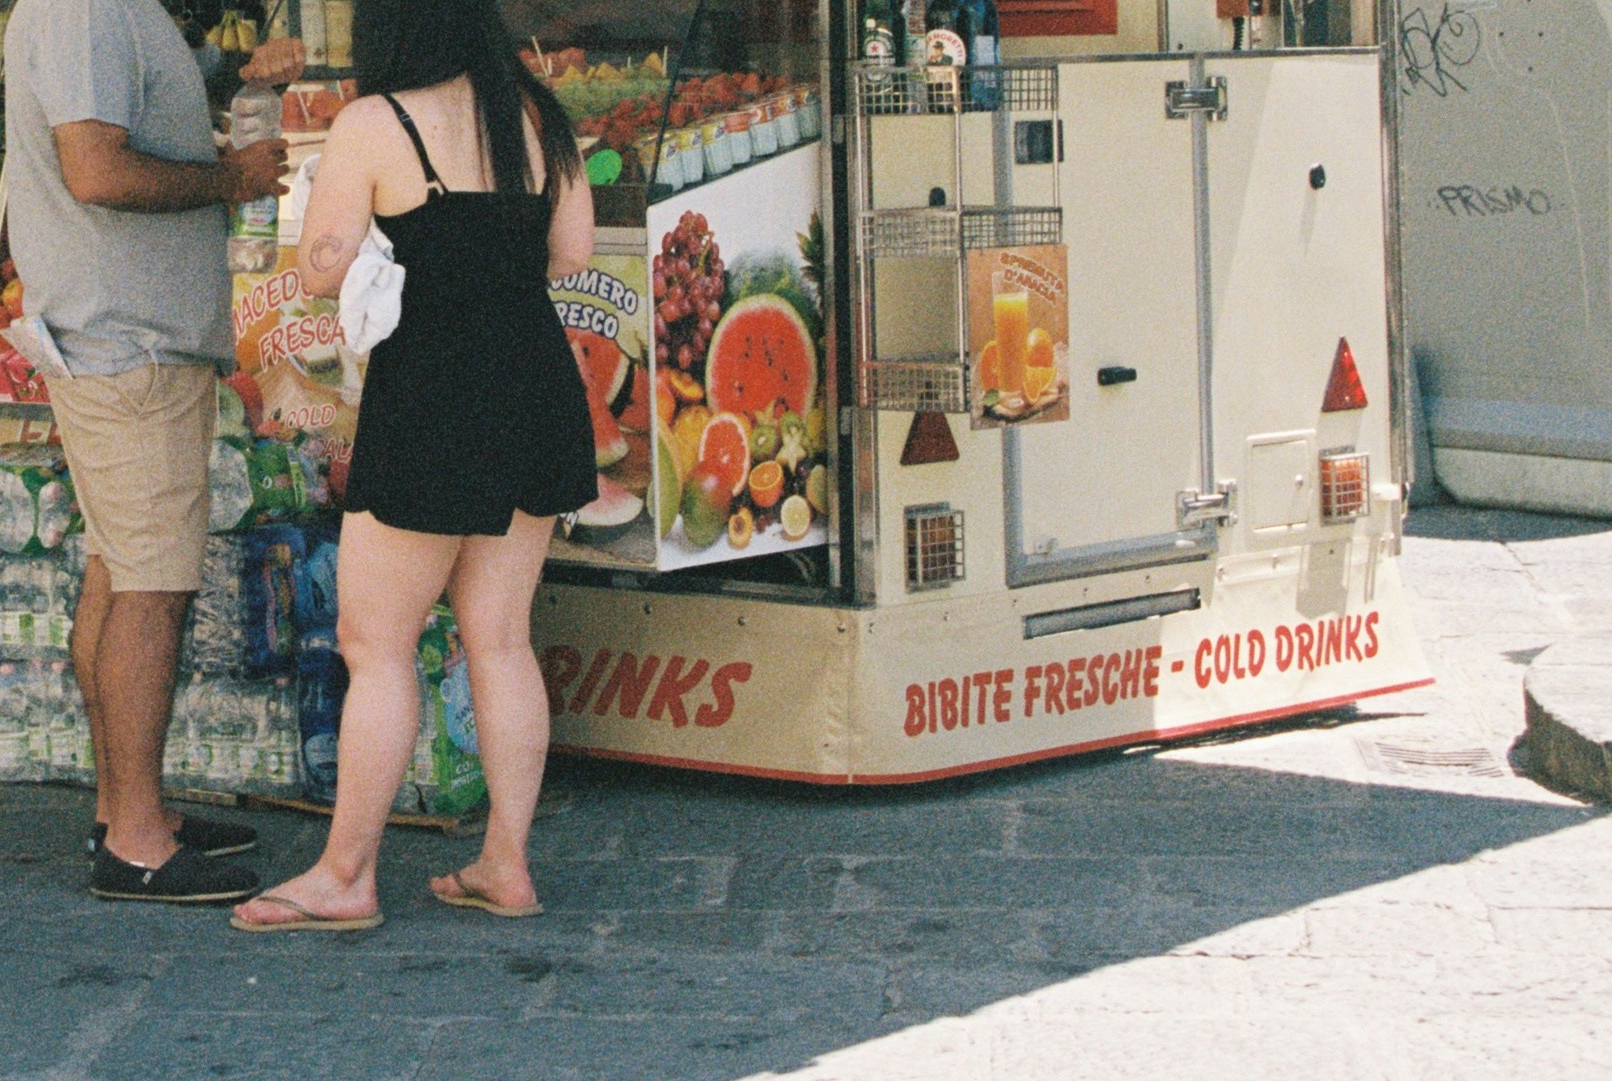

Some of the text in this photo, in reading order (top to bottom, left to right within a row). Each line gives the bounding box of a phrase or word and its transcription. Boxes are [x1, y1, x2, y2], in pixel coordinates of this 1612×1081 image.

[259, 313, 346, 373] FRESCA
[553, 301, 619, 340] RESCO
[286, 404, 336, 428] COLD
[539, 644, 753, 729] RINKS
[903, 668, 1014, 737] BIBITE
[1023, 645, 1163, 718] FRESCHE
[1194, 628, 1266, 689] COLD
[1275, 611, 1380, 673] DRINKS
